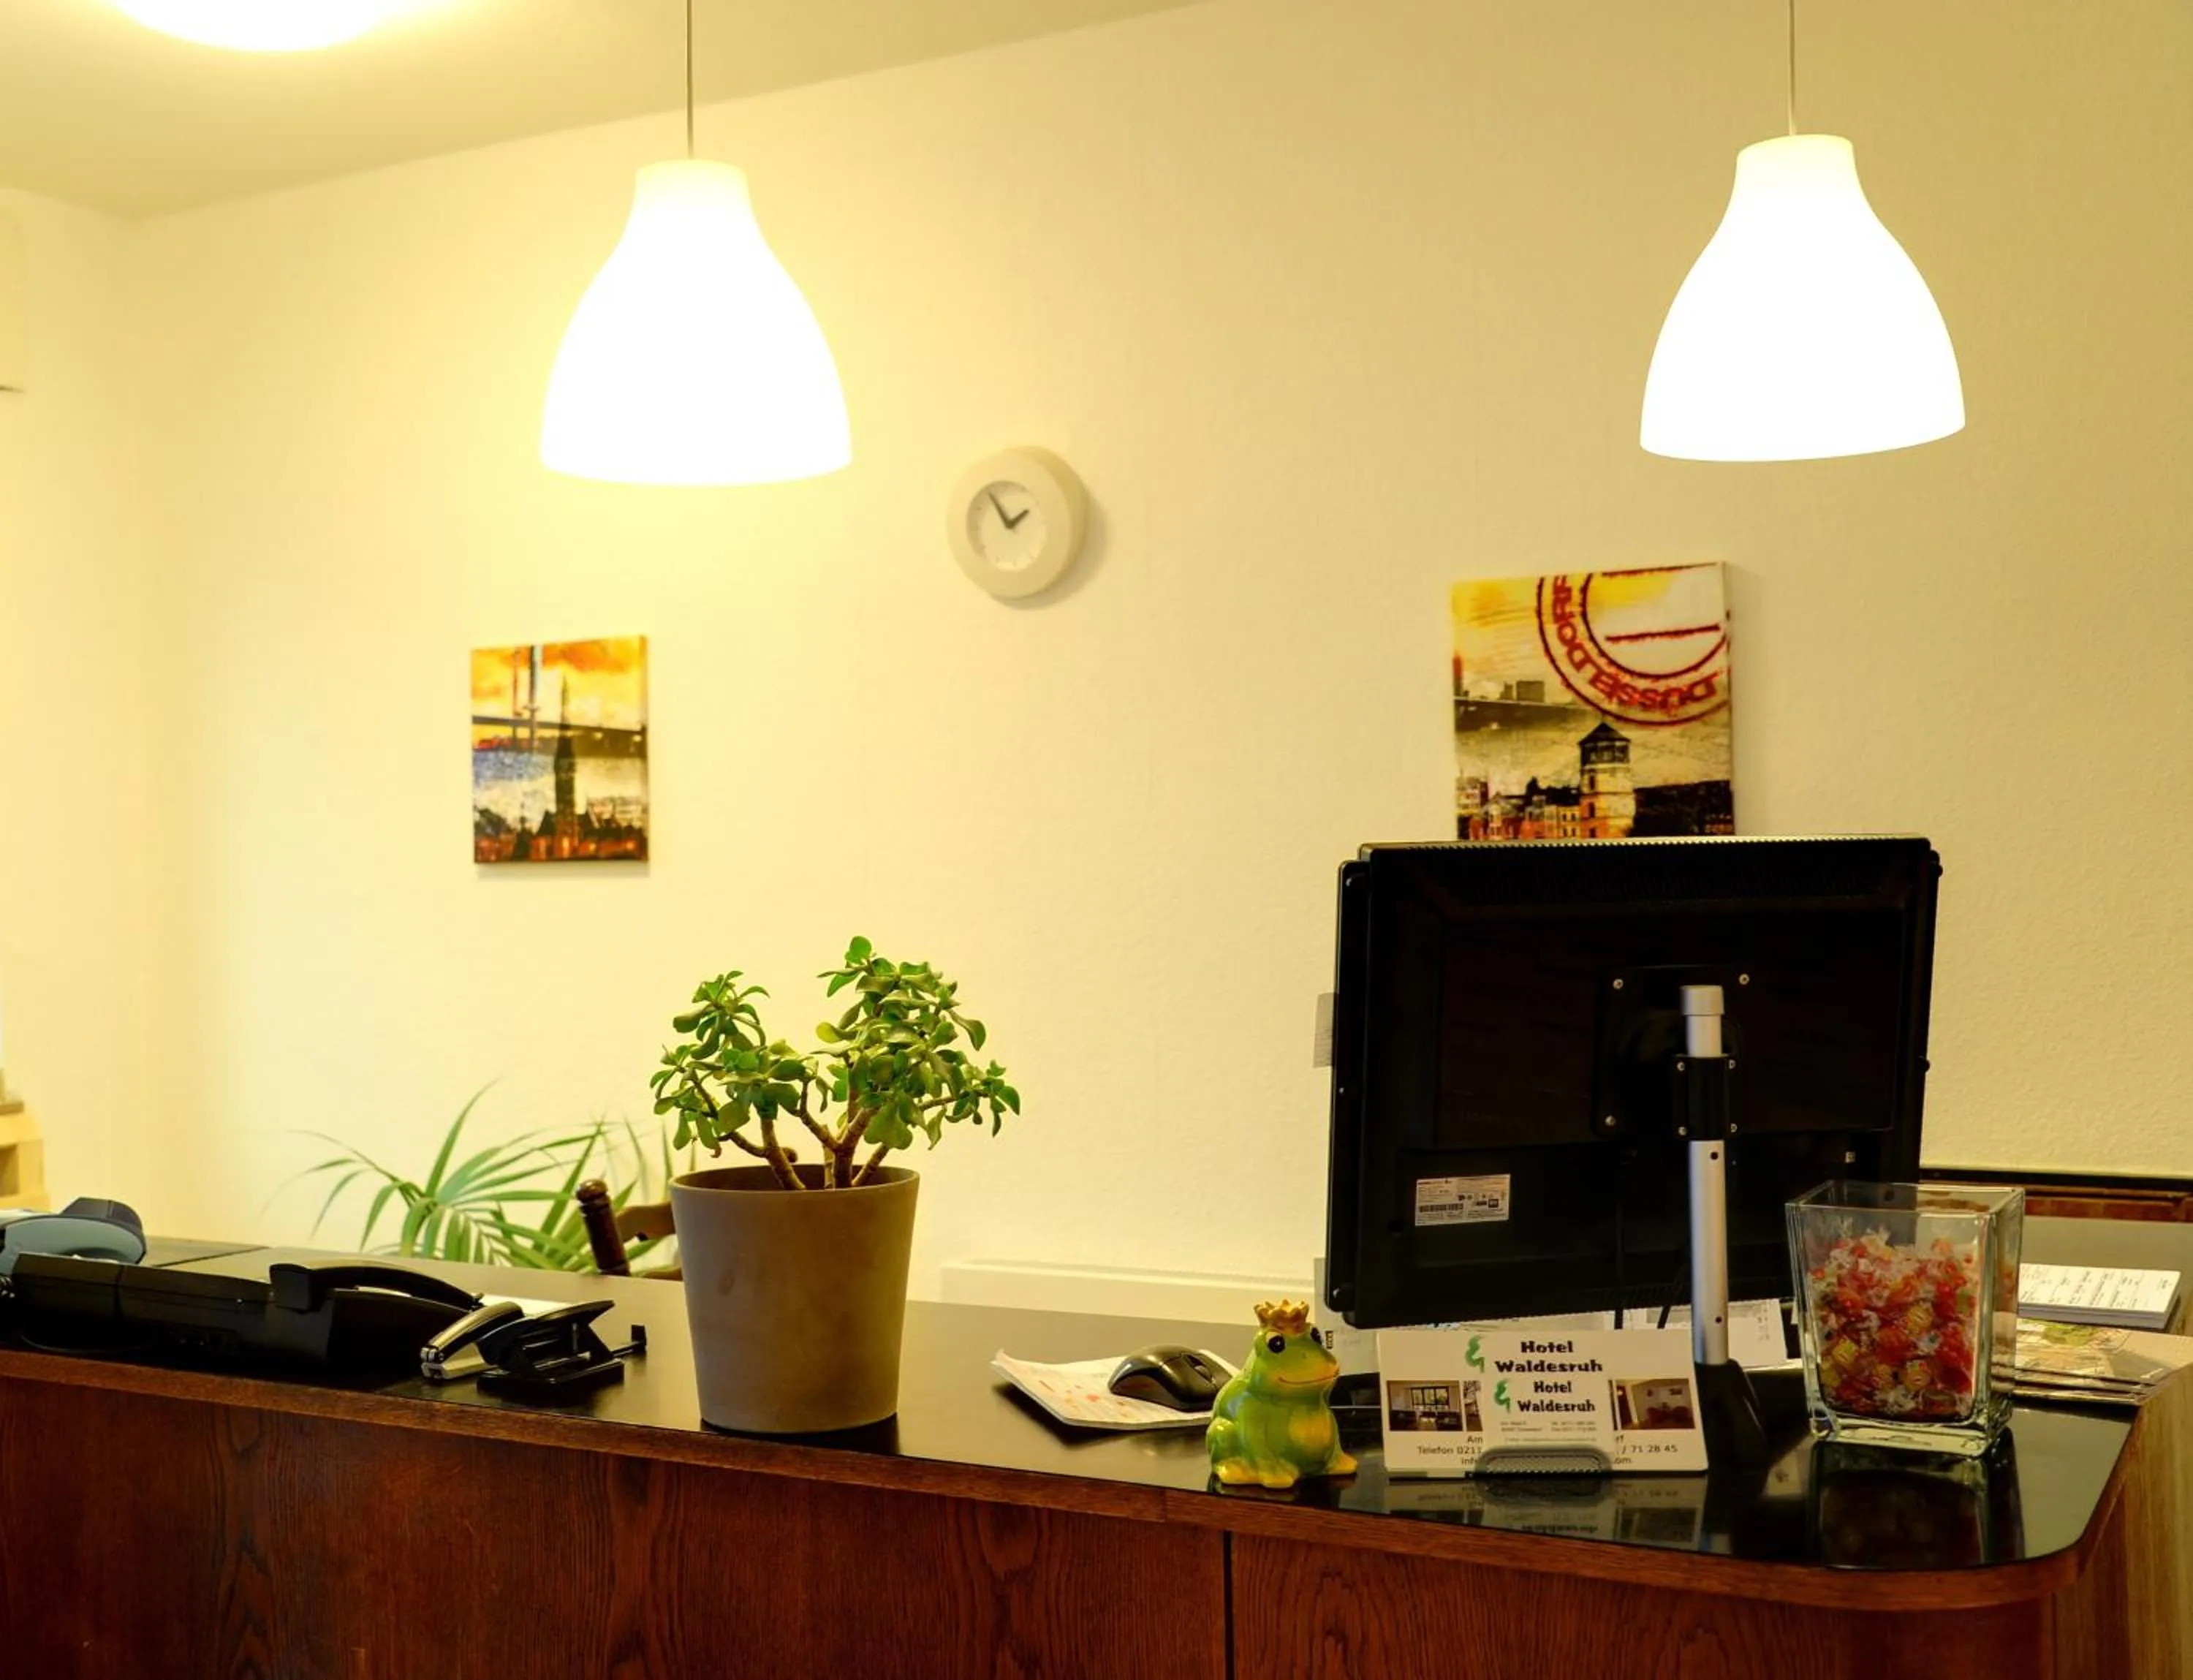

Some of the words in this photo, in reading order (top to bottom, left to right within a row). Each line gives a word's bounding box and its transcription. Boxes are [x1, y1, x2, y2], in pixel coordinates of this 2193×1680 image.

[1520, 1340, 1574, 1353] Hotel
[1494, 1359, 1603, 1373] Waldesruh
[1533, 1380, 1572, 1393] Hotel
[1517, 1399, 1596, 1412] Waldesruh
[1417, 1445, 1454, 1455] Telefon
